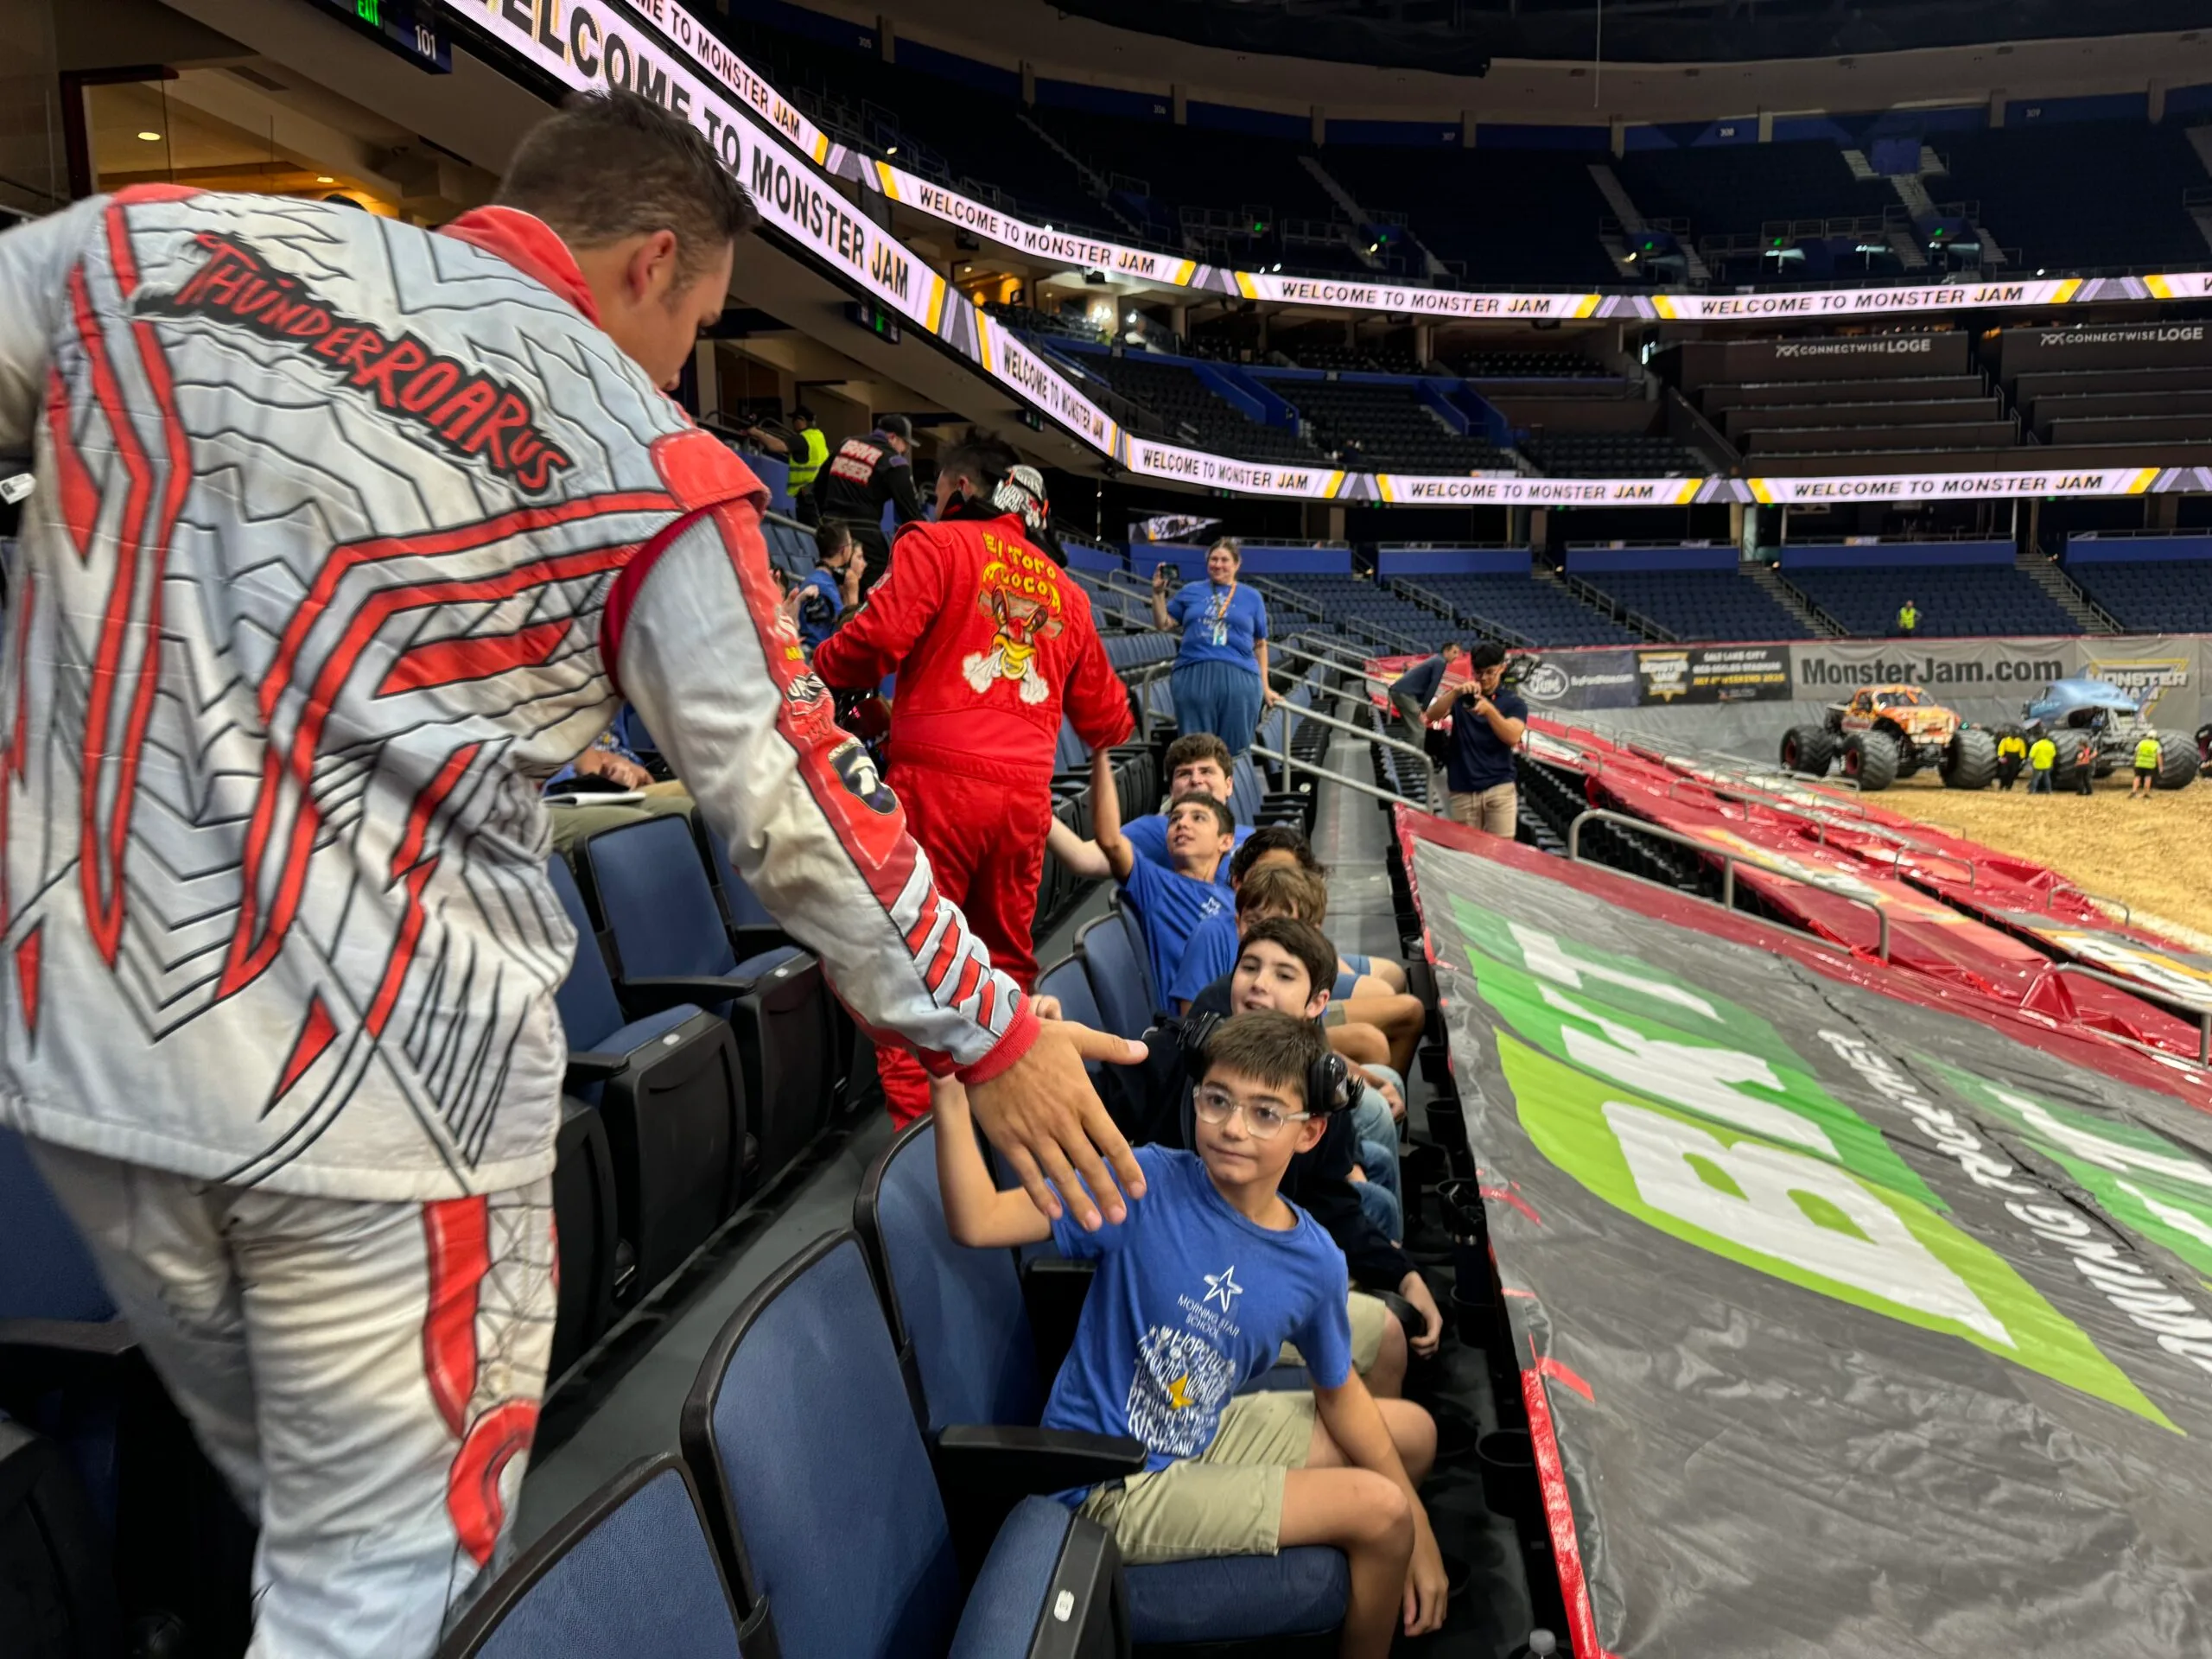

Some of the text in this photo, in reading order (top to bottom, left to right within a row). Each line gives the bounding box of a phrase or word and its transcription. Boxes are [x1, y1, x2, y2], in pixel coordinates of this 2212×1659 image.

[416, 25, 436, 60] 101
[671, 8, 691, 45] TO
[697, 31, 769, 114] MONSTER
[774, 99, 800, 141] JAM
[704, 107, 741, 177] TO
[753, 145, 864, 270] MONSTER
[872, 242, 909, 302] JAM
[919, 184, 1155, 275] WELCOME TO MONSTER JAM
[1281, 282, 1552, 314] WELCOME TO MONSTER JAM
[1701, 285, 2024, 316] WELCOME TO MONSTER JAM
[1800, 340, 1931, 356] CONNECTWISE LOGE
[2064, 327, 2203, 344] CONNECTWISE LOGE
[1004, 341, 1047, 399] WELCOME
[1051, 381, 1059, 410] TO
[1062, 389, 1090, 433] MONSTER
[1143, 447, 1309, 491] WELCOME TO MONSTER JAM
[1411, 483, 1655, 499] WELCOME TO MONSTER JAM
[1795, 474, 2104, 498] WELCOME TO MONSTER JAM
[1801, 656, 2063, 687] MonsterJam.com
[1508, 921, 2018, 1350] BKT
[1177, 1294, 1240, 1338] MORNING STAR
[1185, 1313, 1221, 1338] SCHOOL
